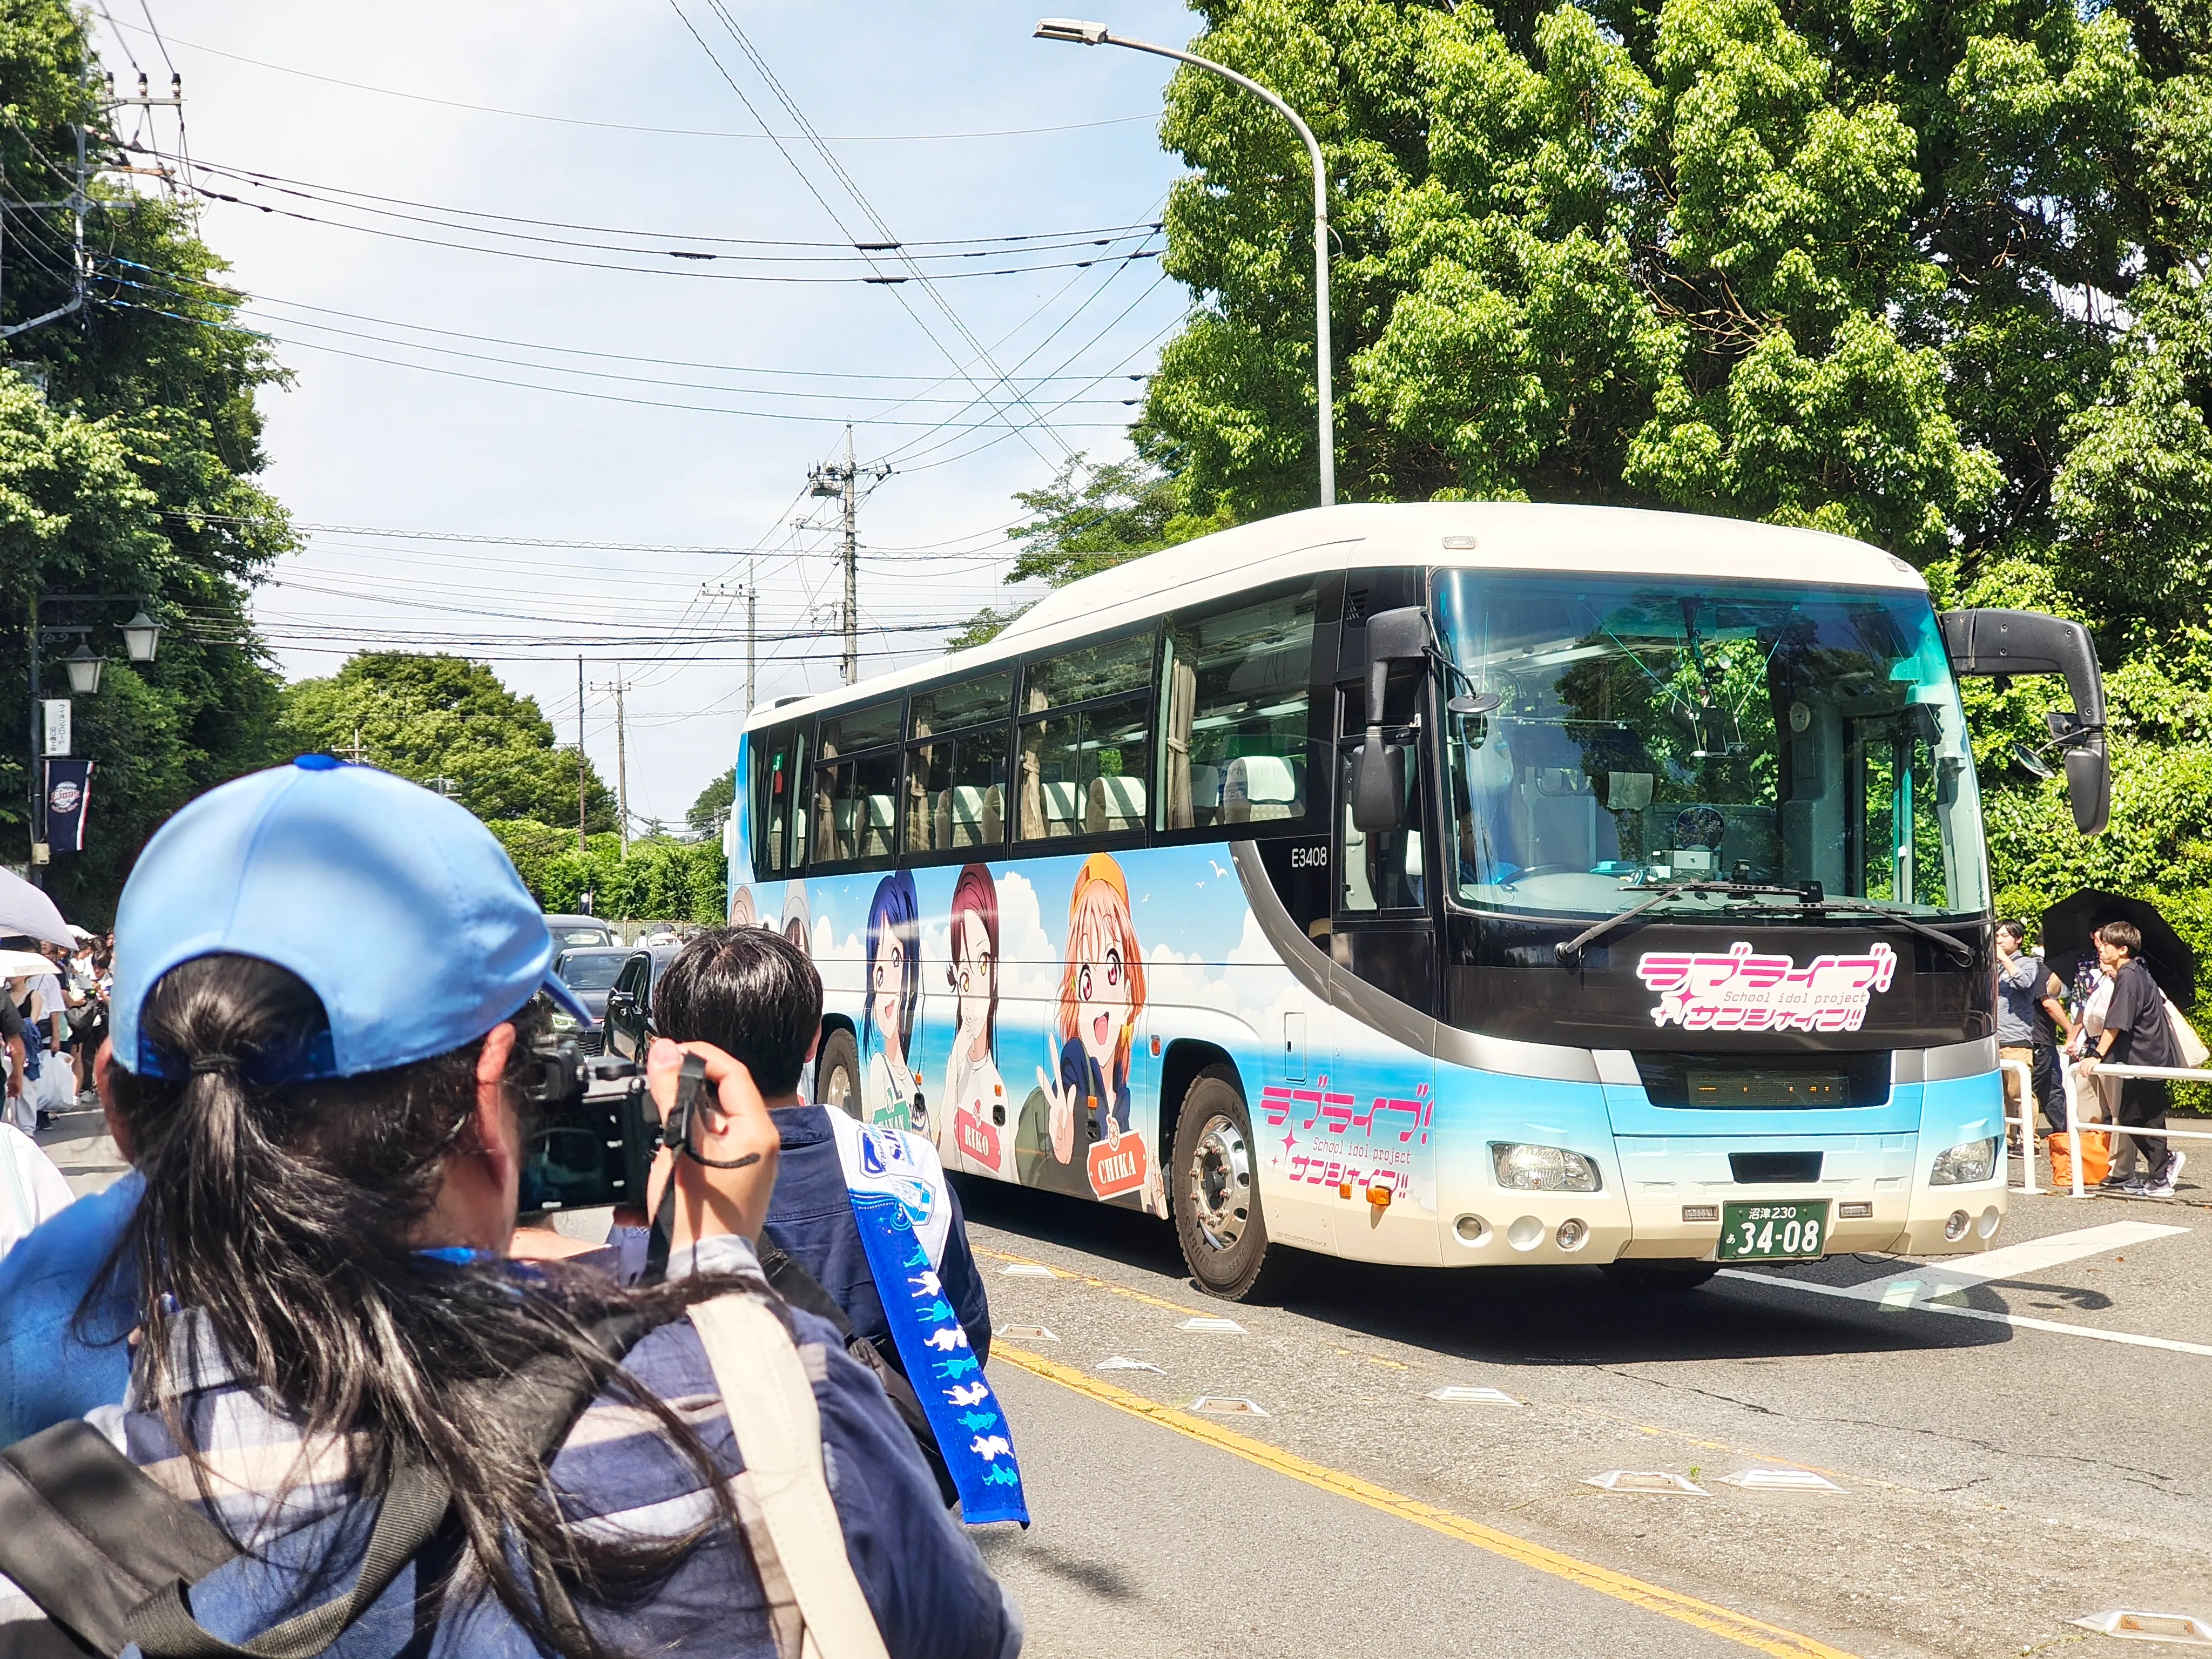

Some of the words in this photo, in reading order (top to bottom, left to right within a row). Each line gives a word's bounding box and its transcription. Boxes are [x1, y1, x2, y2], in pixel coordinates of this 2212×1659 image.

[1292, 846, 1327, 868] E3408
[1723, 991, 1771, 1003] School
[1778, 992, 1808, 1004] idol
[1814, 992, 1866, 1006] project
[964, 1123, 989, 1157] RIKO
[1313, 1136, 1344, 1155] School
[1348, 1142, 1368, 1158] idol
[1372, 1147, 1411, 1165] project
[1098, 1150, 1137, 1184] CHIKA
[1737, 1219, 1819, 1255] 34-08
